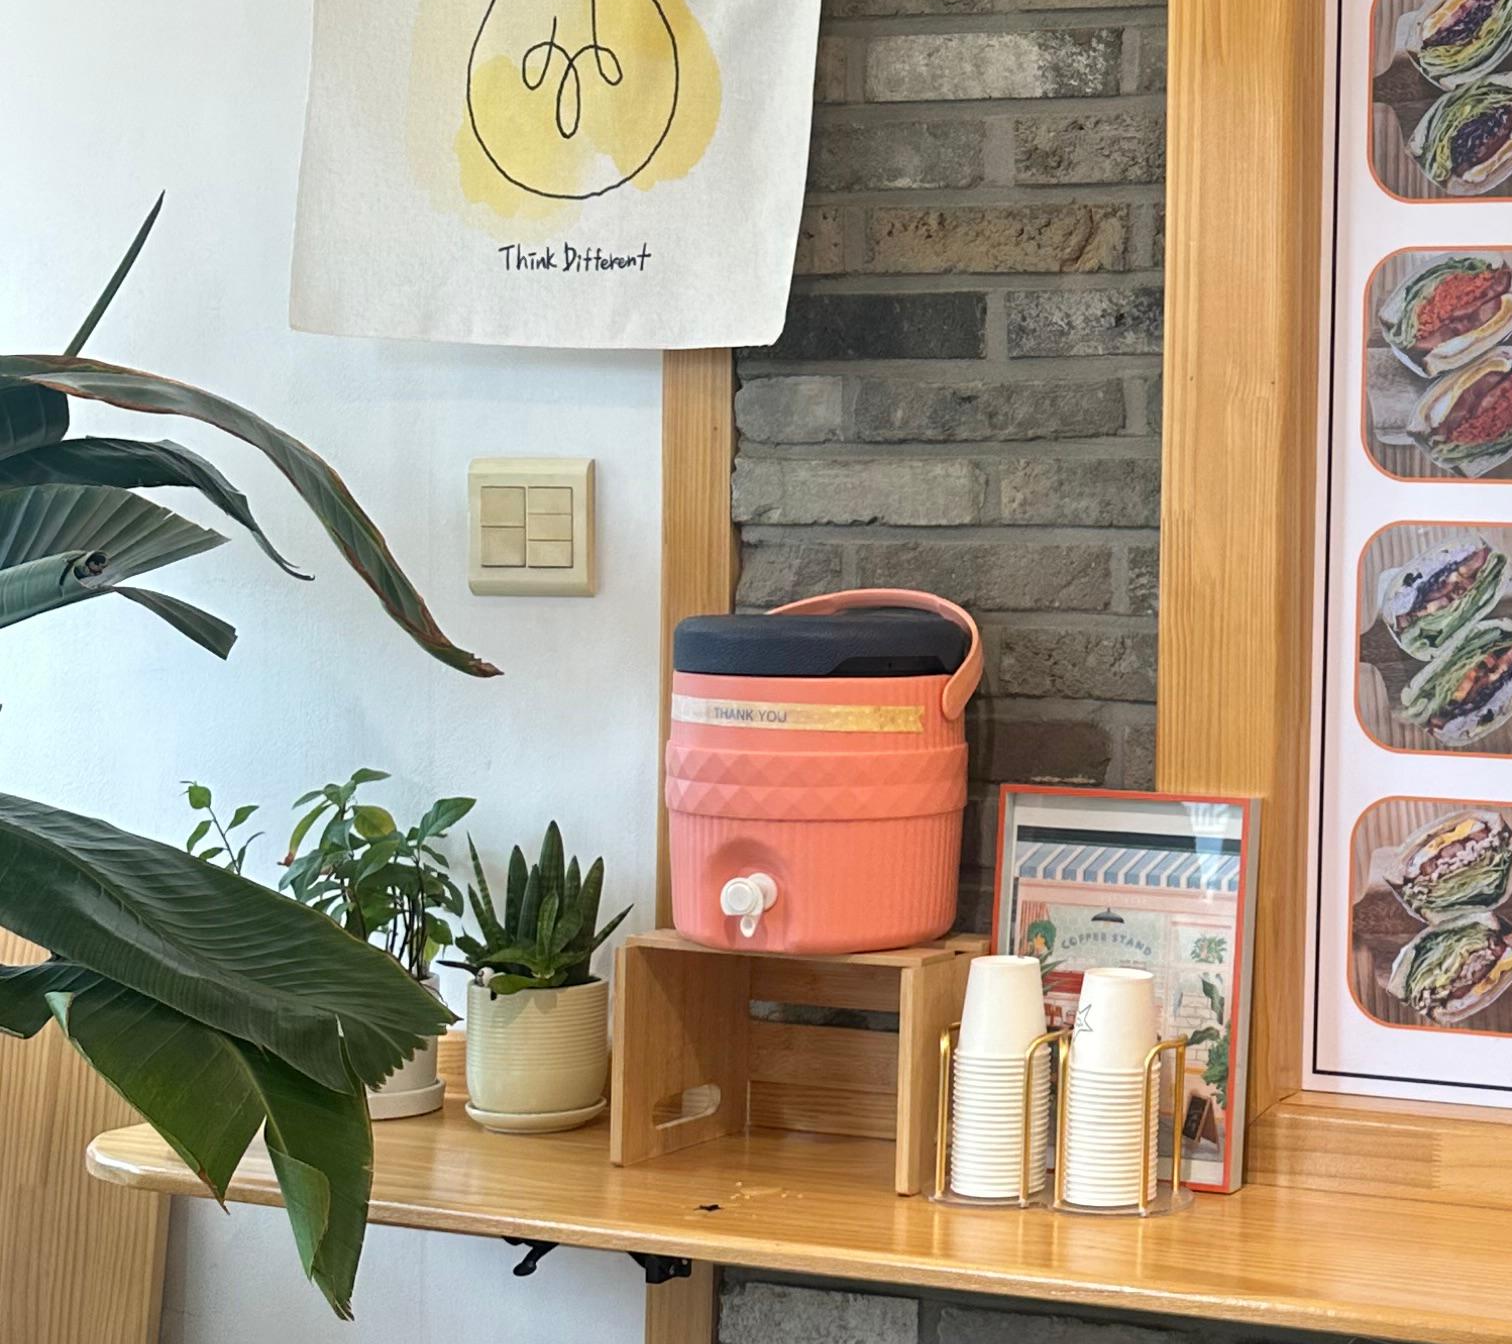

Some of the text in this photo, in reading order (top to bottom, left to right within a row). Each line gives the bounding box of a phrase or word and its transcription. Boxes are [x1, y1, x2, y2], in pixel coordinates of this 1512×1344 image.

[498, 242, 652, 273] Think Different
[714, 707, 787, 724] THANK YOU
